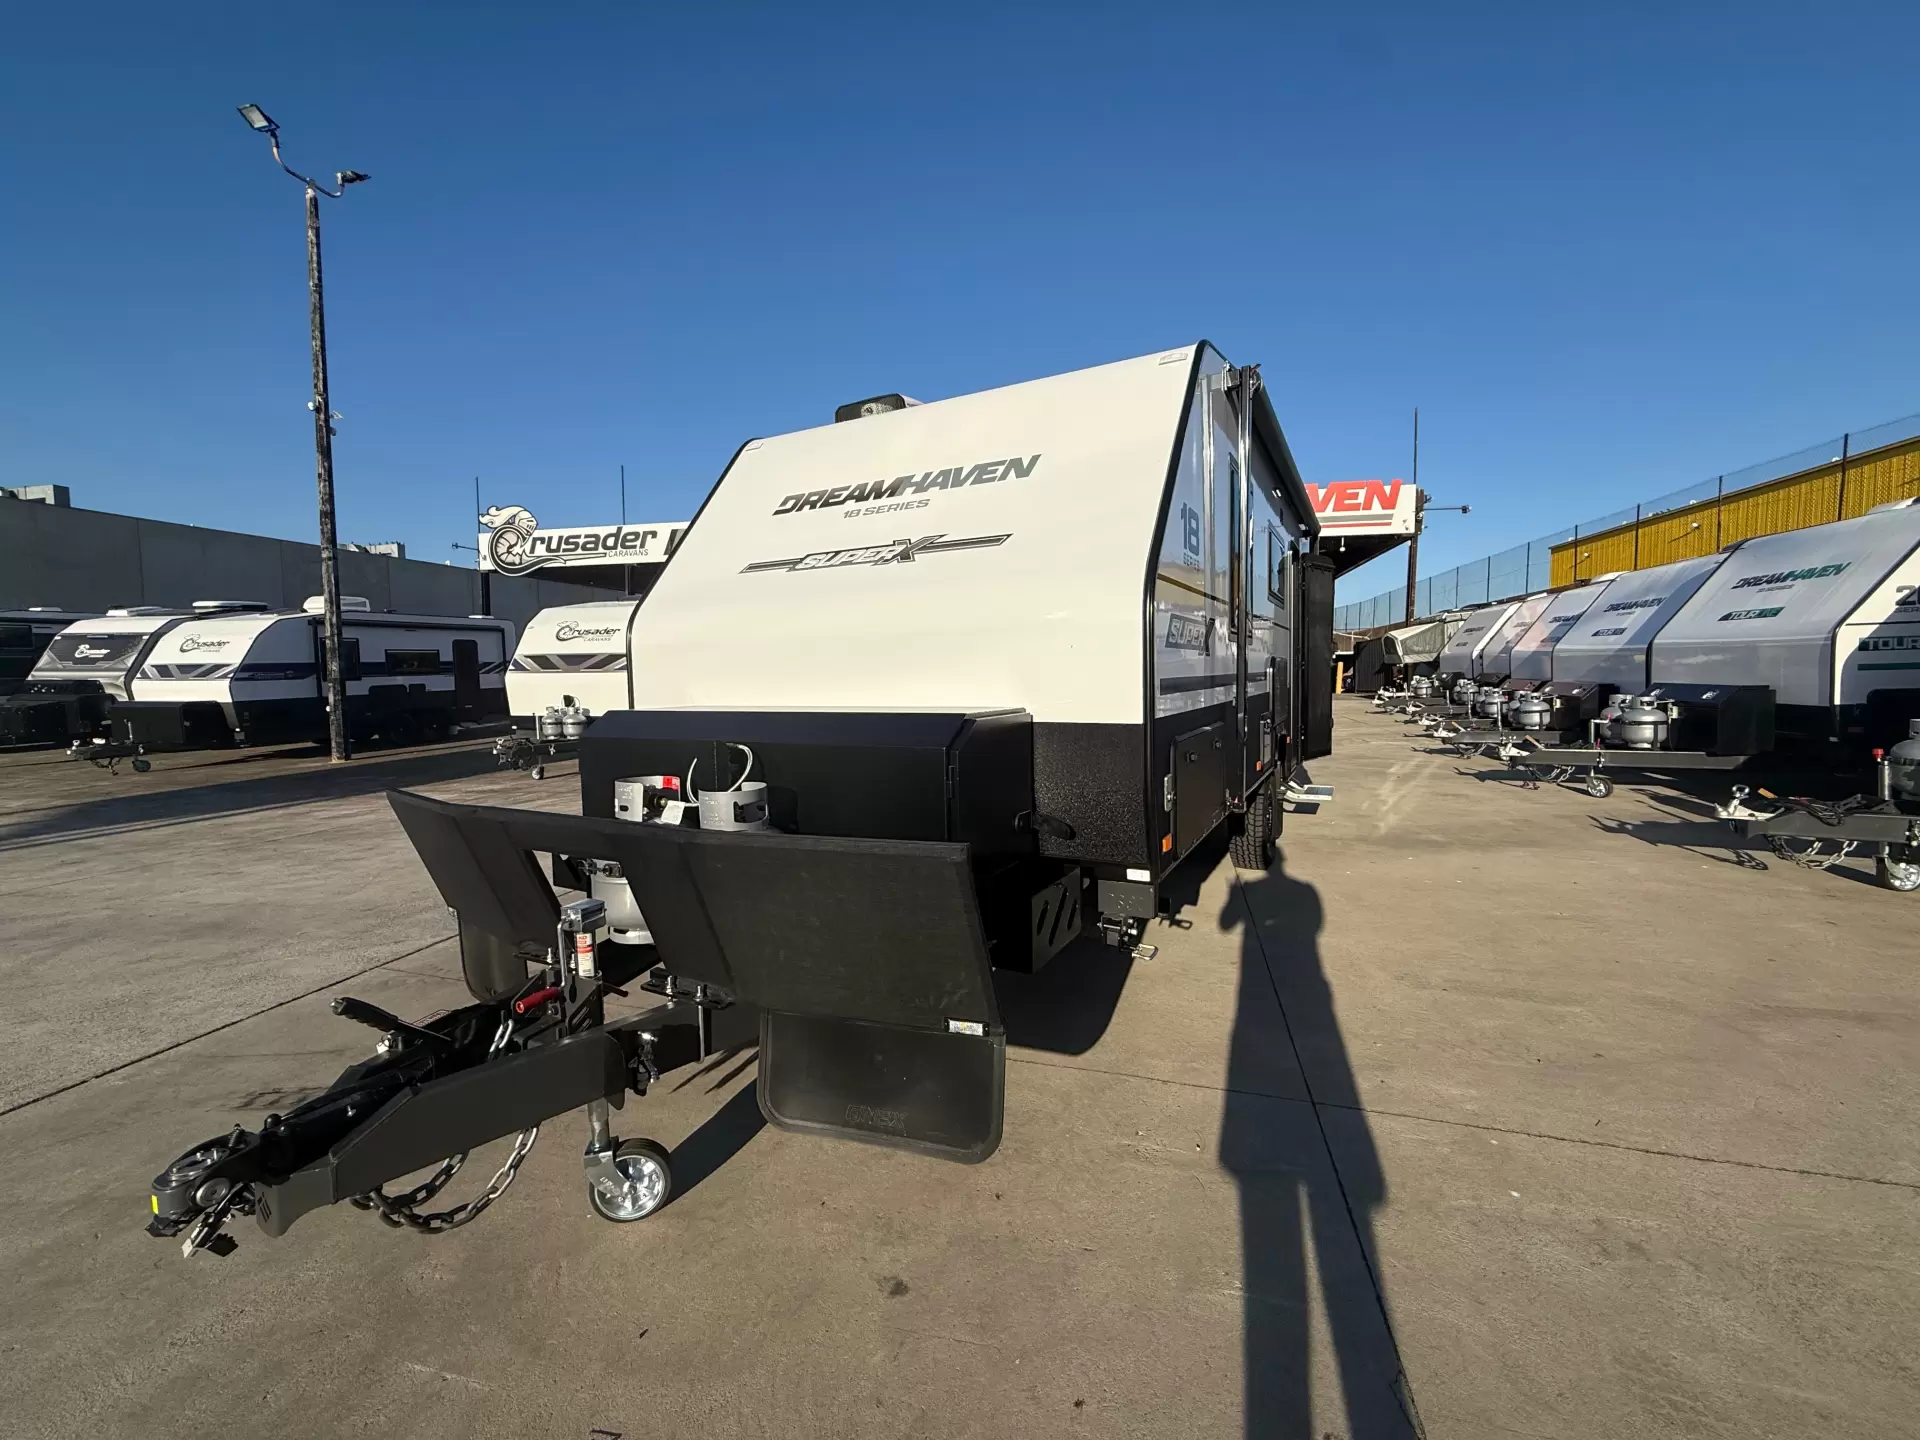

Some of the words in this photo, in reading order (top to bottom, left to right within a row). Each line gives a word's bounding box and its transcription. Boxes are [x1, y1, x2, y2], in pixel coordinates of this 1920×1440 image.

[772, 453, 1042, 516] DREAMHAVEN
[843, 509, 861, 519] 18
[863, 498, 931, 516] SERIES
[1180, 502, 1200, 556] 18
[608, 548, 649, 558] CARAVANS
[1731, 562, 1852, 590] DREAMHAVEN
